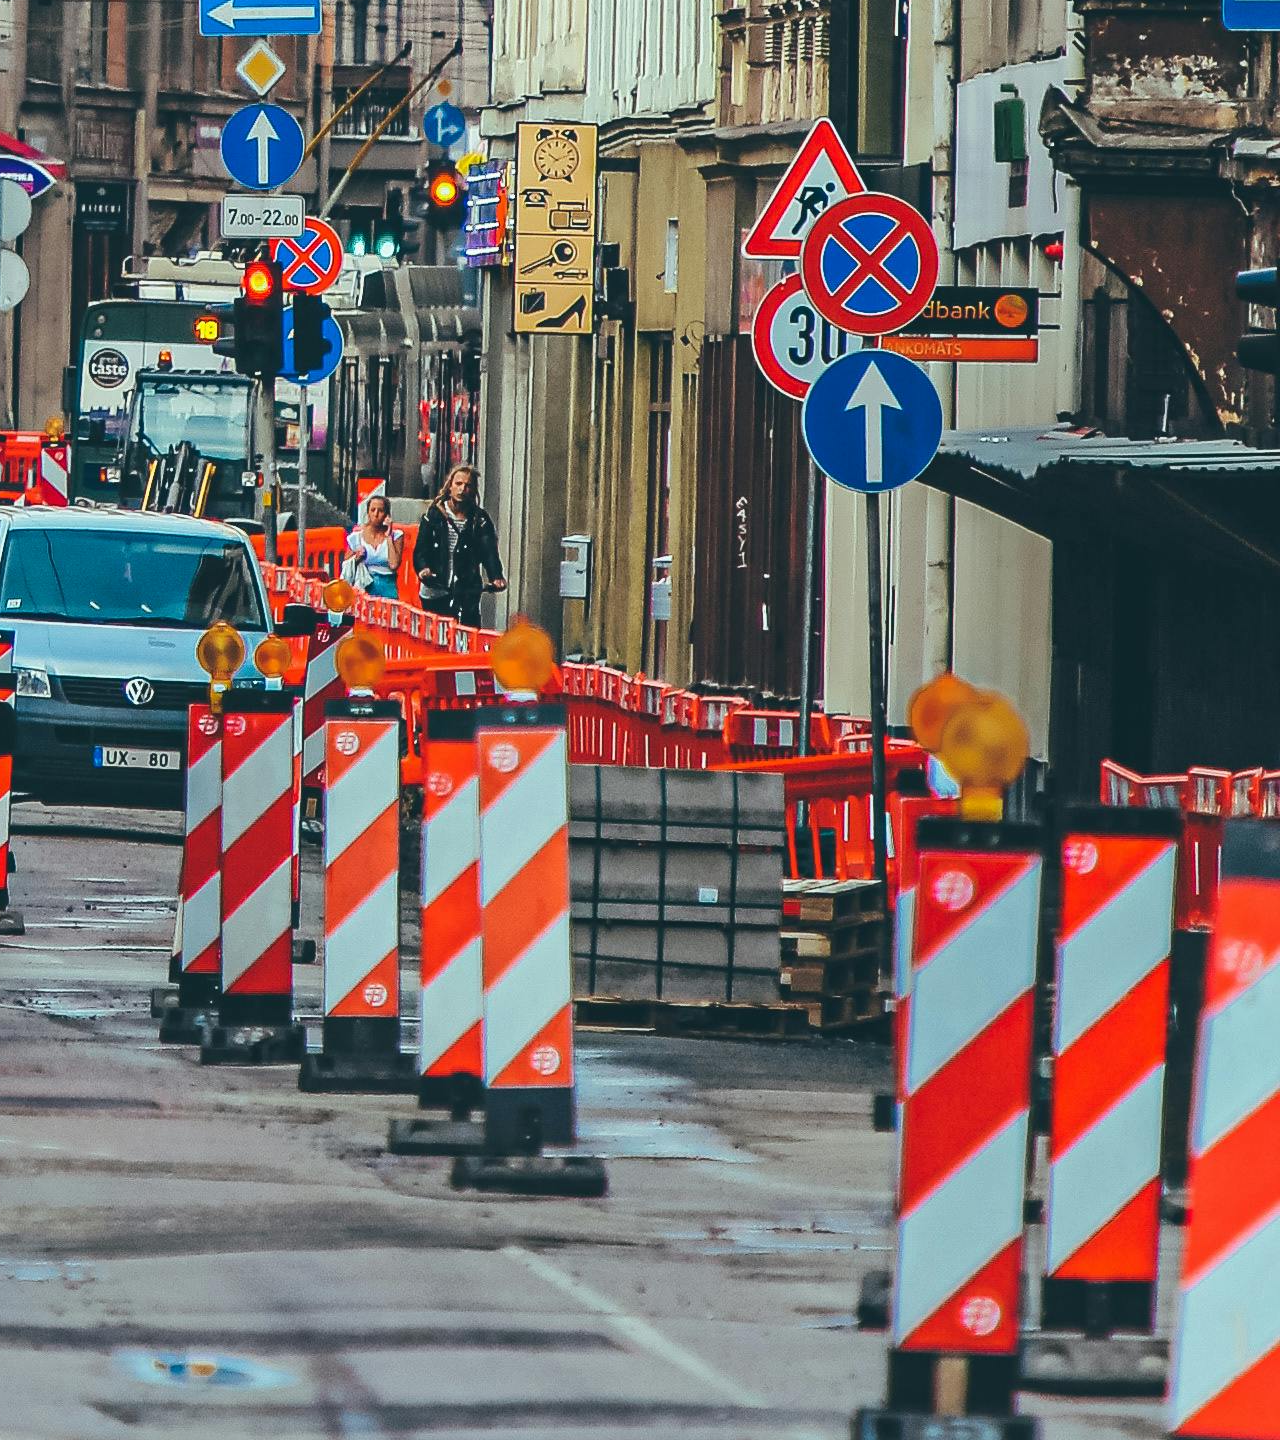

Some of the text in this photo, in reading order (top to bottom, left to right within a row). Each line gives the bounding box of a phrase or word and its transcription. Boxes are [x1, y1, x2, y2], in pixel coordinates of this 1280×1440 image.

[228, 208, 299, 227] 7.00-22.00
[788, 305, 848, 366] 30
[91, 362, 128, 376] taste
[149, 752, 169, 768] 80
